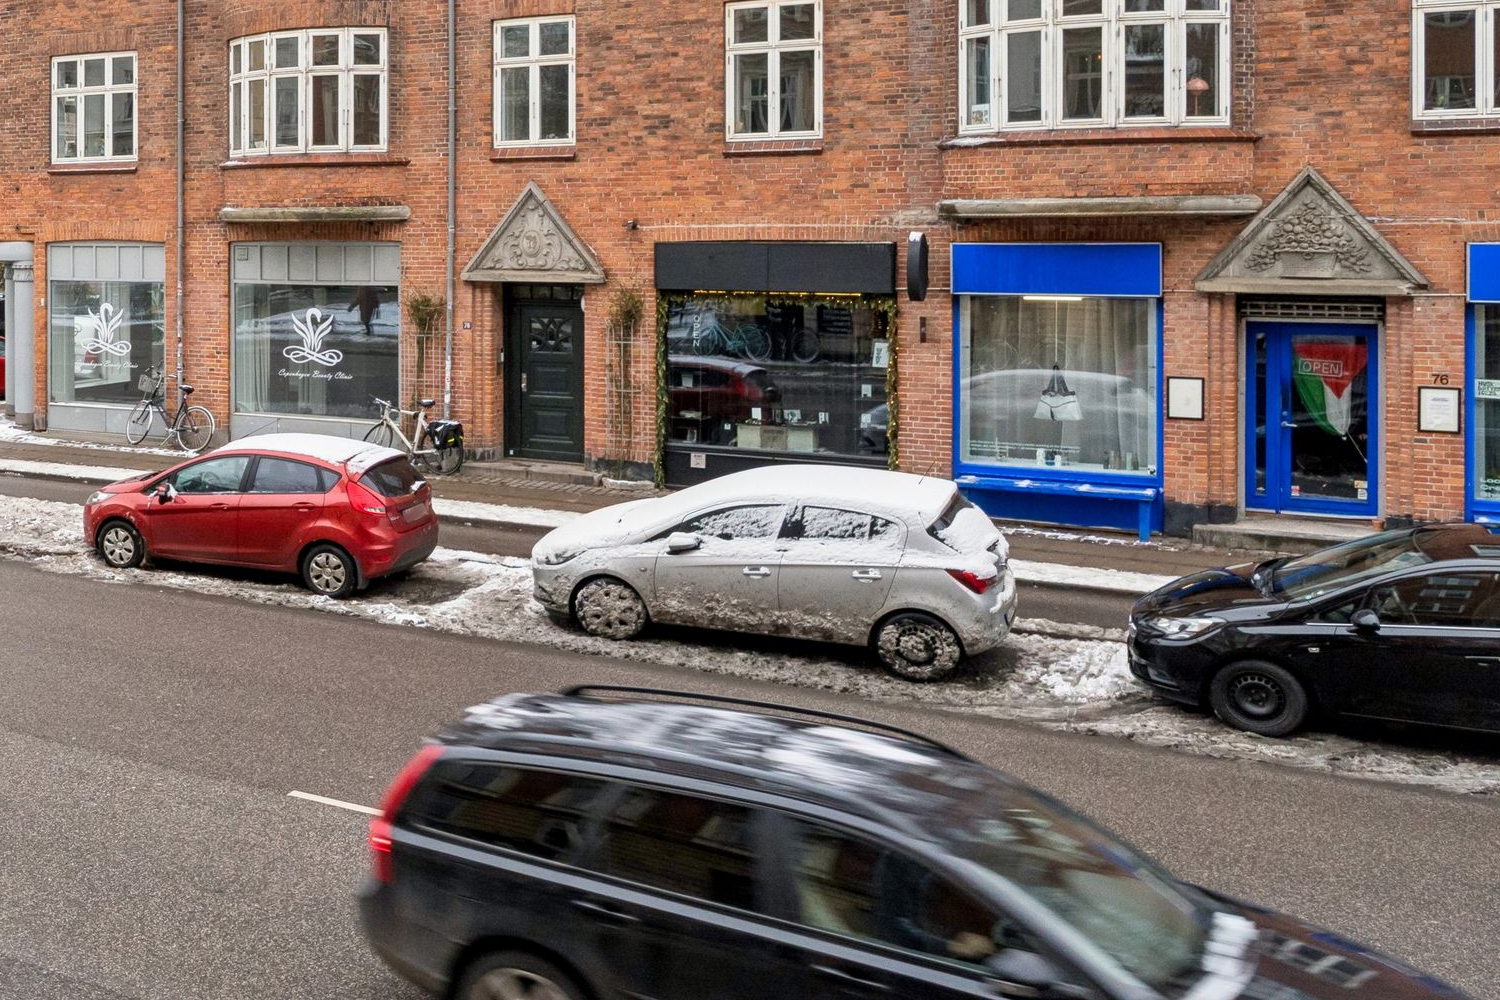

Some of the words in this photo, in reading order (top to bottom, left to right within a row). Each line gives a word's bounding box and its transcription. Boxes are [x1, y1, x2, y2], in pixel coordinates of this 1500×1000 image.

[1302, 361, 1339, 374] OPEN
[278, 368, 310, 379] Copenhagen
[312, 370, 333, 381] Beauty
[334, 371, 353, 379] Clinic
[1431, 374, 1449, 385] 76
